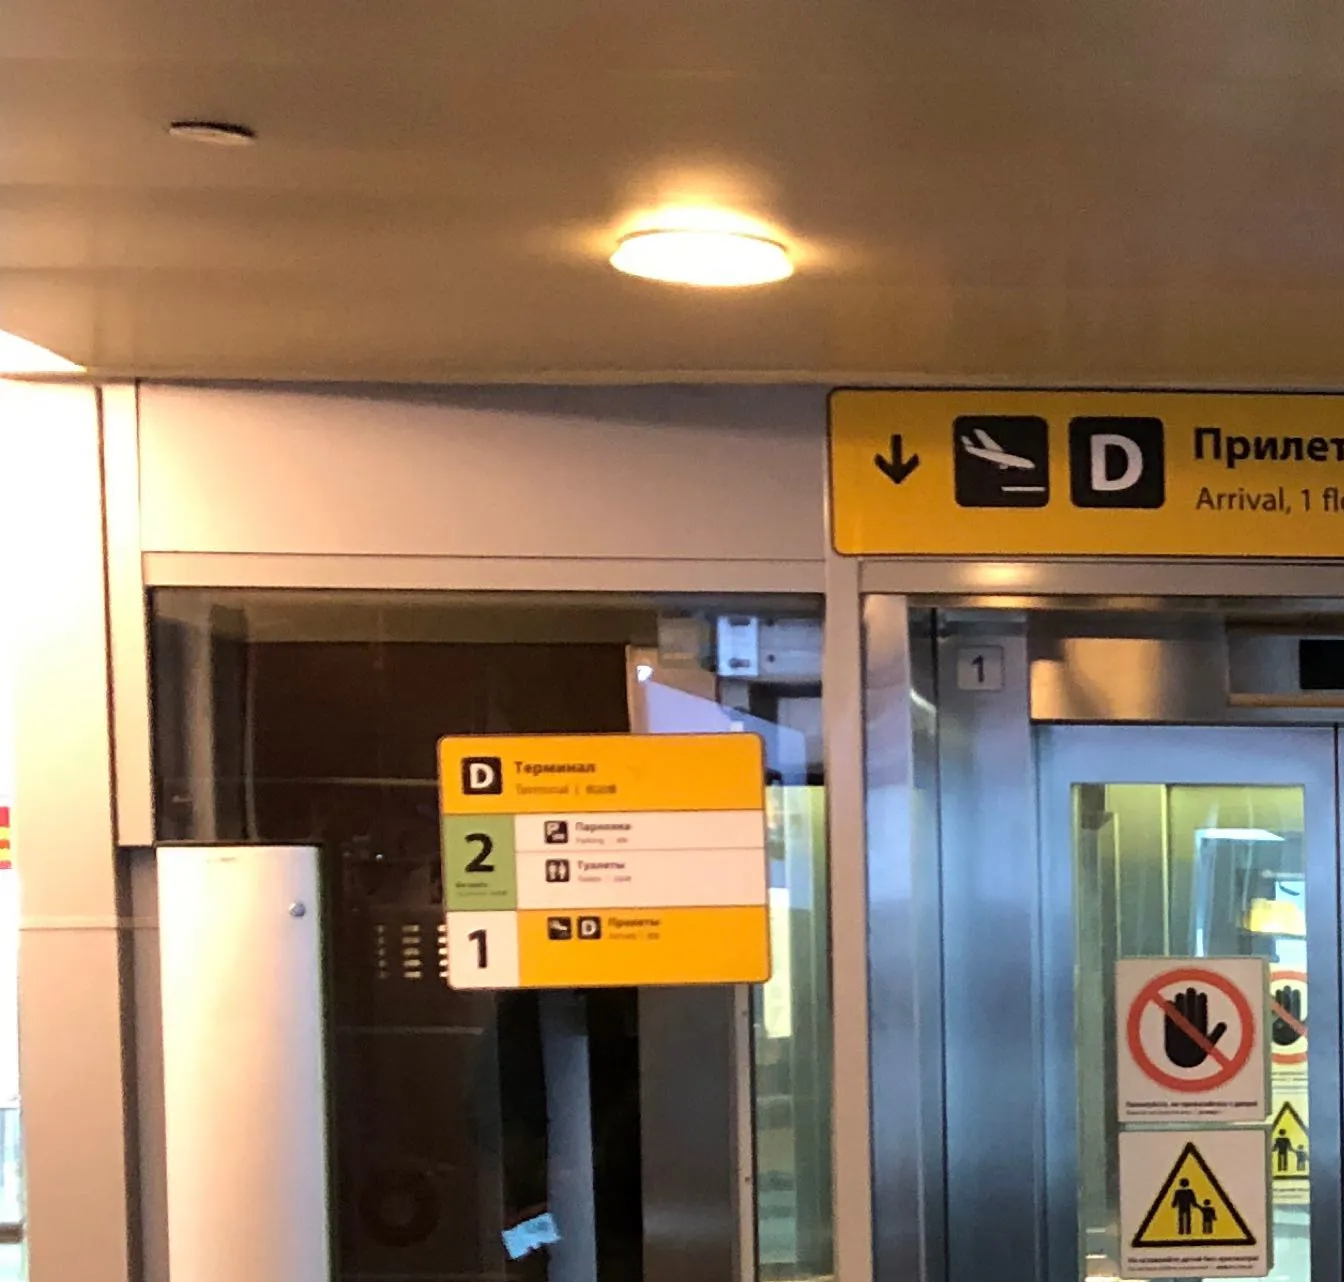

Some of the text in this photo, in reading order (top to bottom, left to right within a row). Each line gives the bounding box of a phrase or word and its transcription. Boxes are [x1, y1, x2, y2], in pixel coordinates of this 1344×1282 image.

[1091, 434, 1143, 491] D
[1195, 486, 1291, 515] Arrival,
[1301, 488, 1311, 512] 1
[971, 655, 984, 682] 1
[469, 762, 494, 789] D
[464, 833, 495, 873] 2
[581, 919, 597, 936] D
[468, 929, 488, 969] 1
